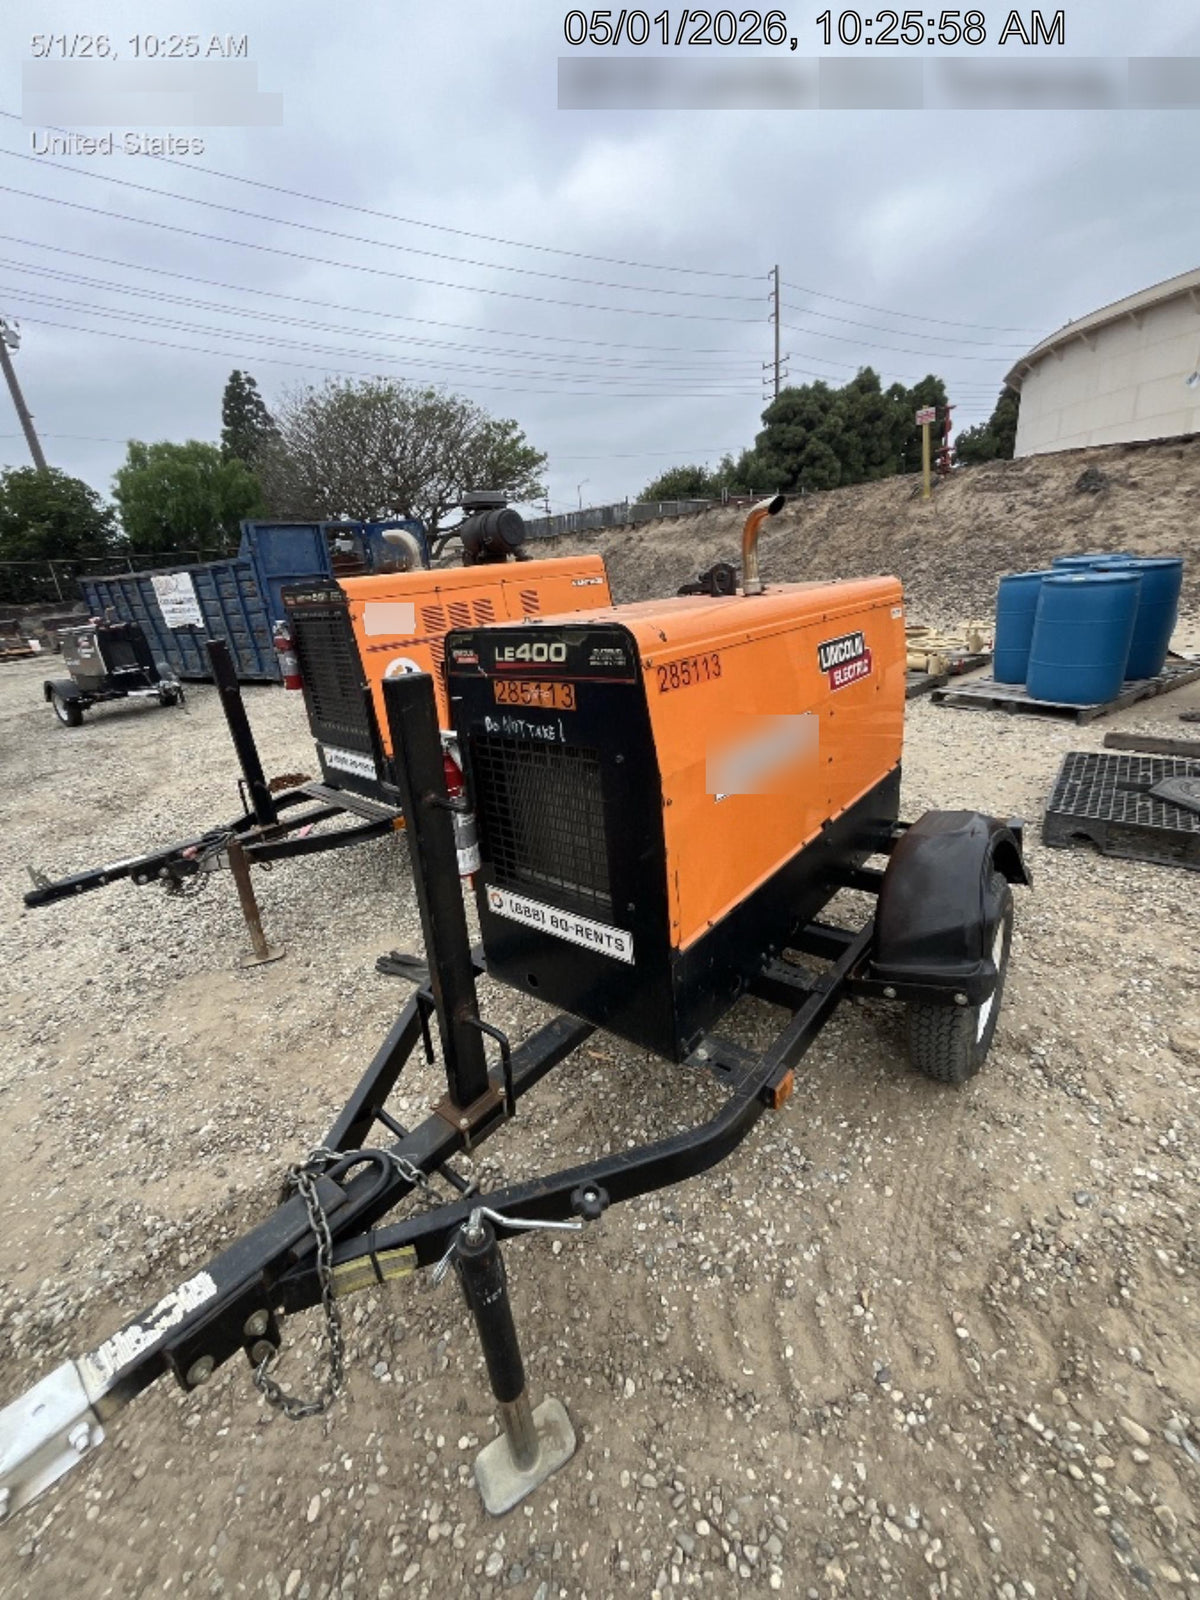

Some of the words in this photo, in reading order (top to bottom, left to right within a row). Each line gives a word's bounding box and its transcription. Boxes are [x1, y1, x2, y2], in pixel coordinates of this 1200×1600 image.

[495, 642, 567, 662] LE400
[820, 636, 863, 668] LINCOLN
[657, 653, 721, 694] 285113
[495, 680, 573, 709] 285113
